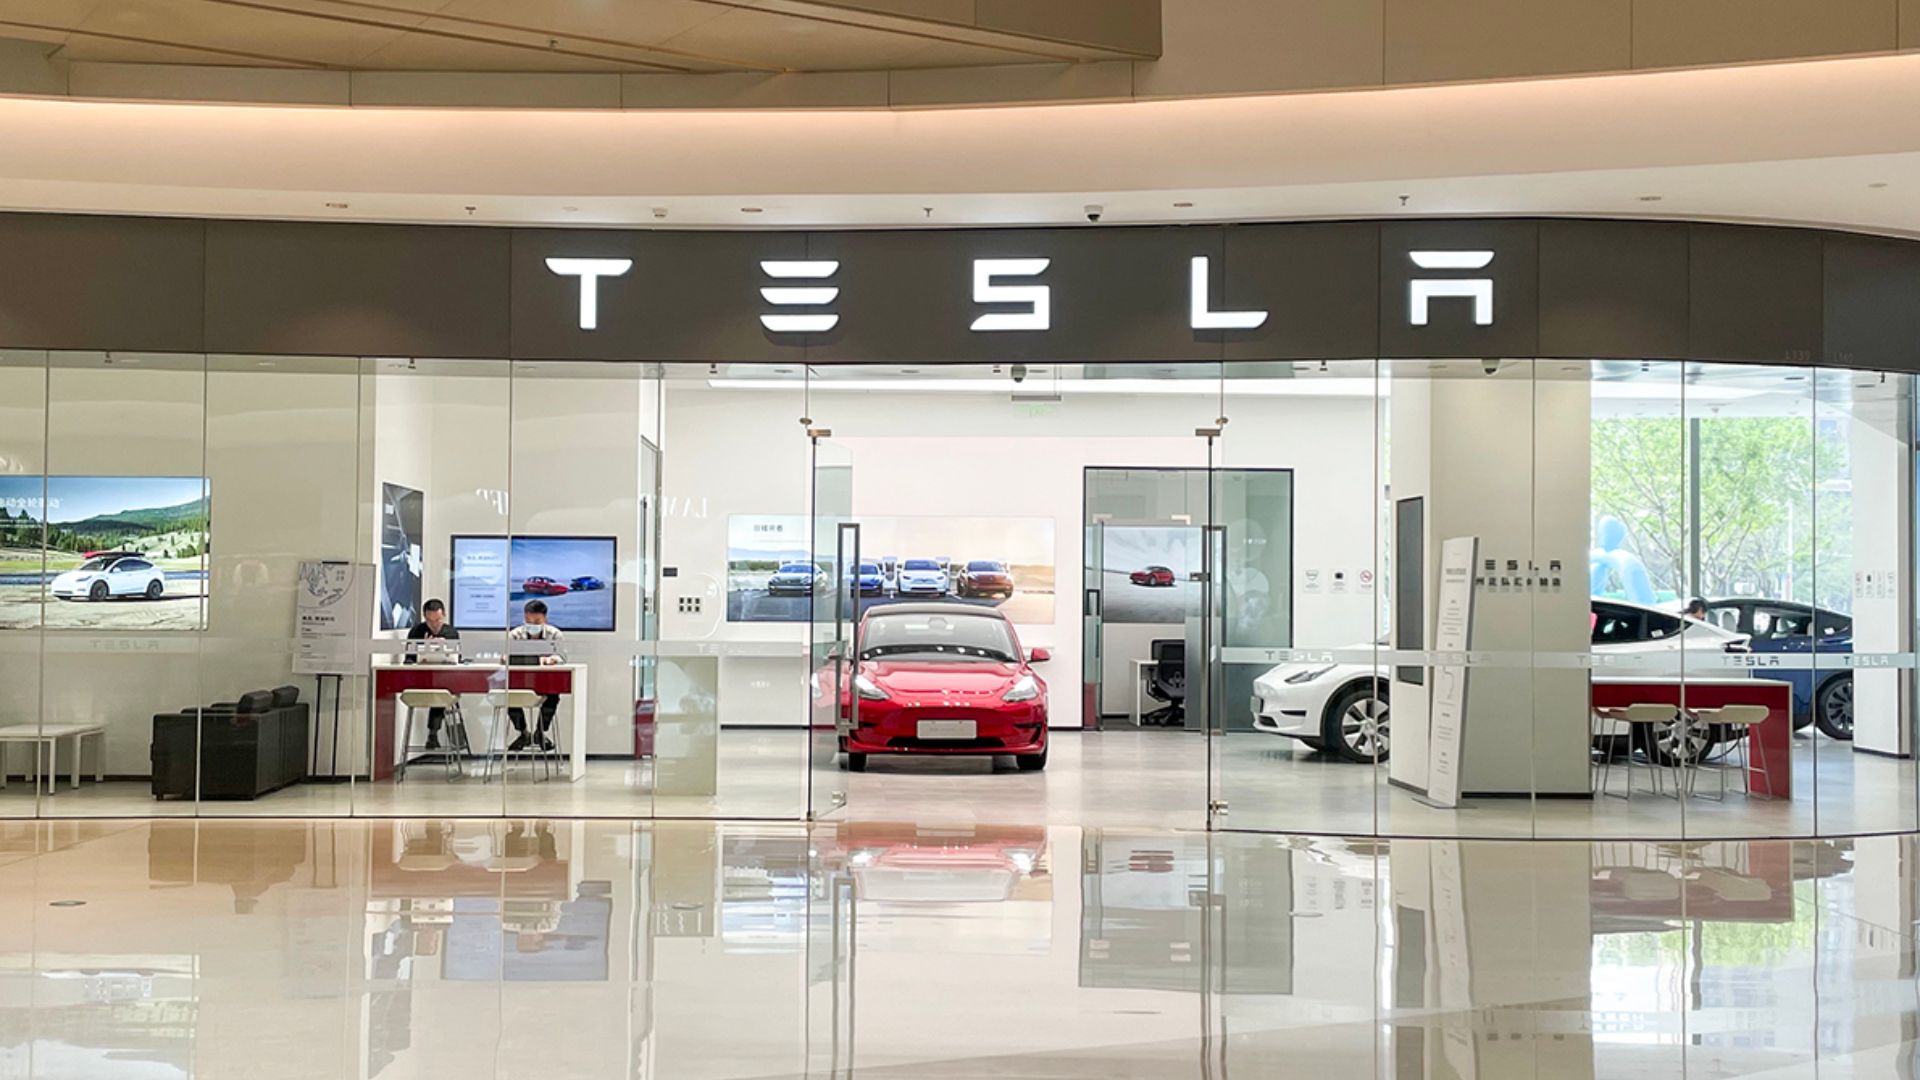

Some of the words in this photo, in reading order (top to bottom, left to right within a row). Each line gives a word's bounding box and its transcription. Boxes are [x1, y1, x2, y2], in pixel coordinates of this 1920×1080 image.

[545, 249, 1495, 332] TESLA
[1484, 559, 1561, 571] ESLA
[1264, 650, 1333, 662] TESLA
[1721, 655, 1780, 666] TESLA
[1843, 655, 1889, 666] TESLA
